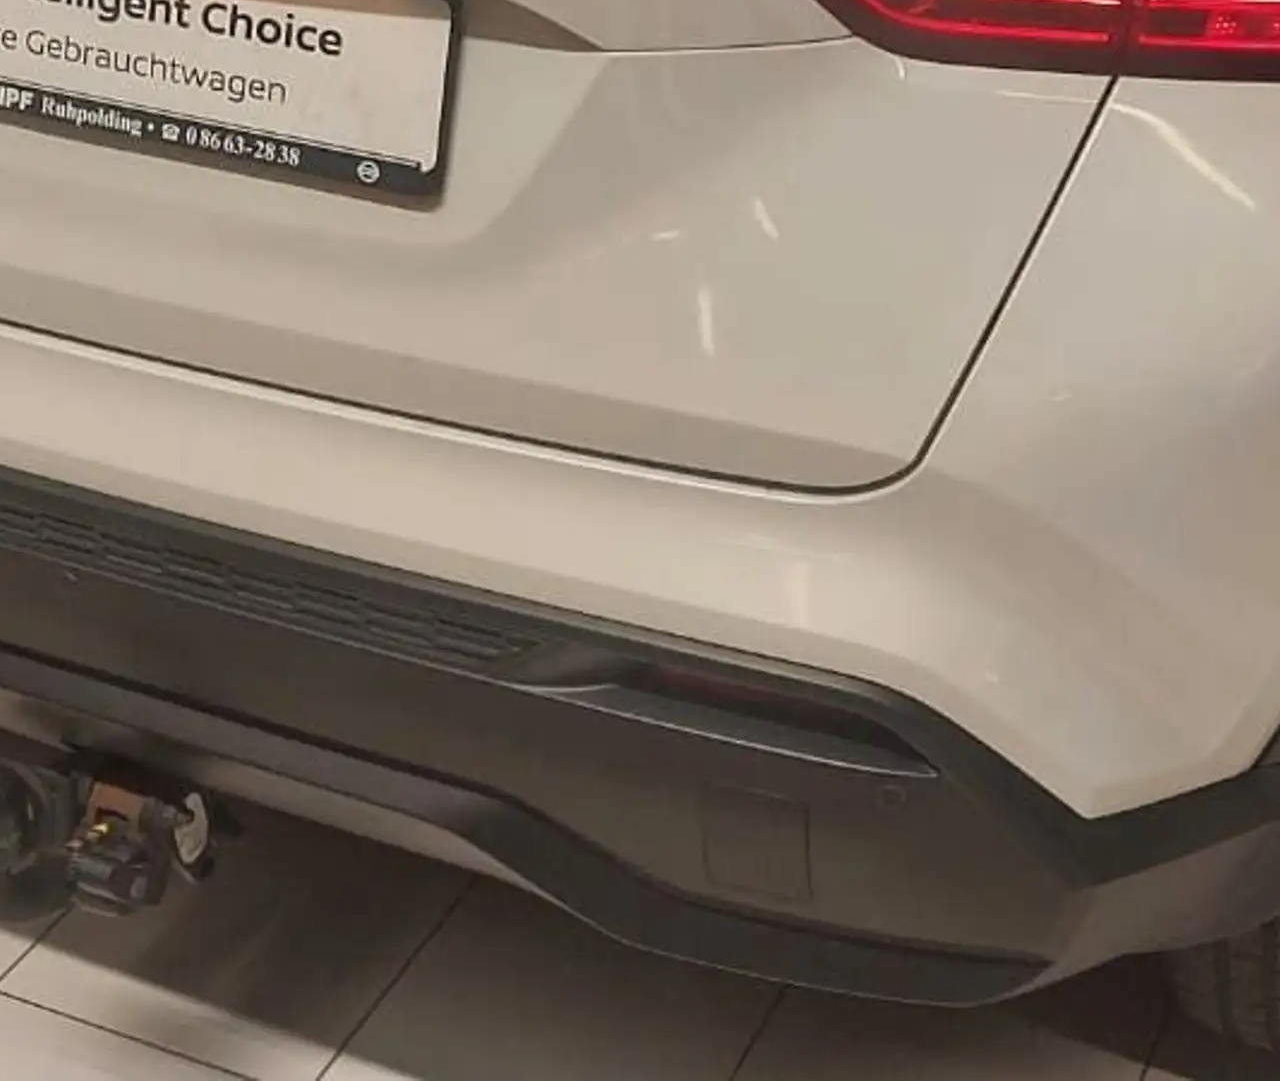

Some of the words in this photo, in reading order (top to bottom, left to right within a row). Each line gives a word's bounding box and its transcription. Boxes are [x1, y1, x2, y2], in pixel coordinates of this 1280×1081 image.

[201, 1, 343, 57] Choice
[25, 29, 287, 105] Gebrauchtwagen
[40, 94, 143, 138] Ruhpolding
